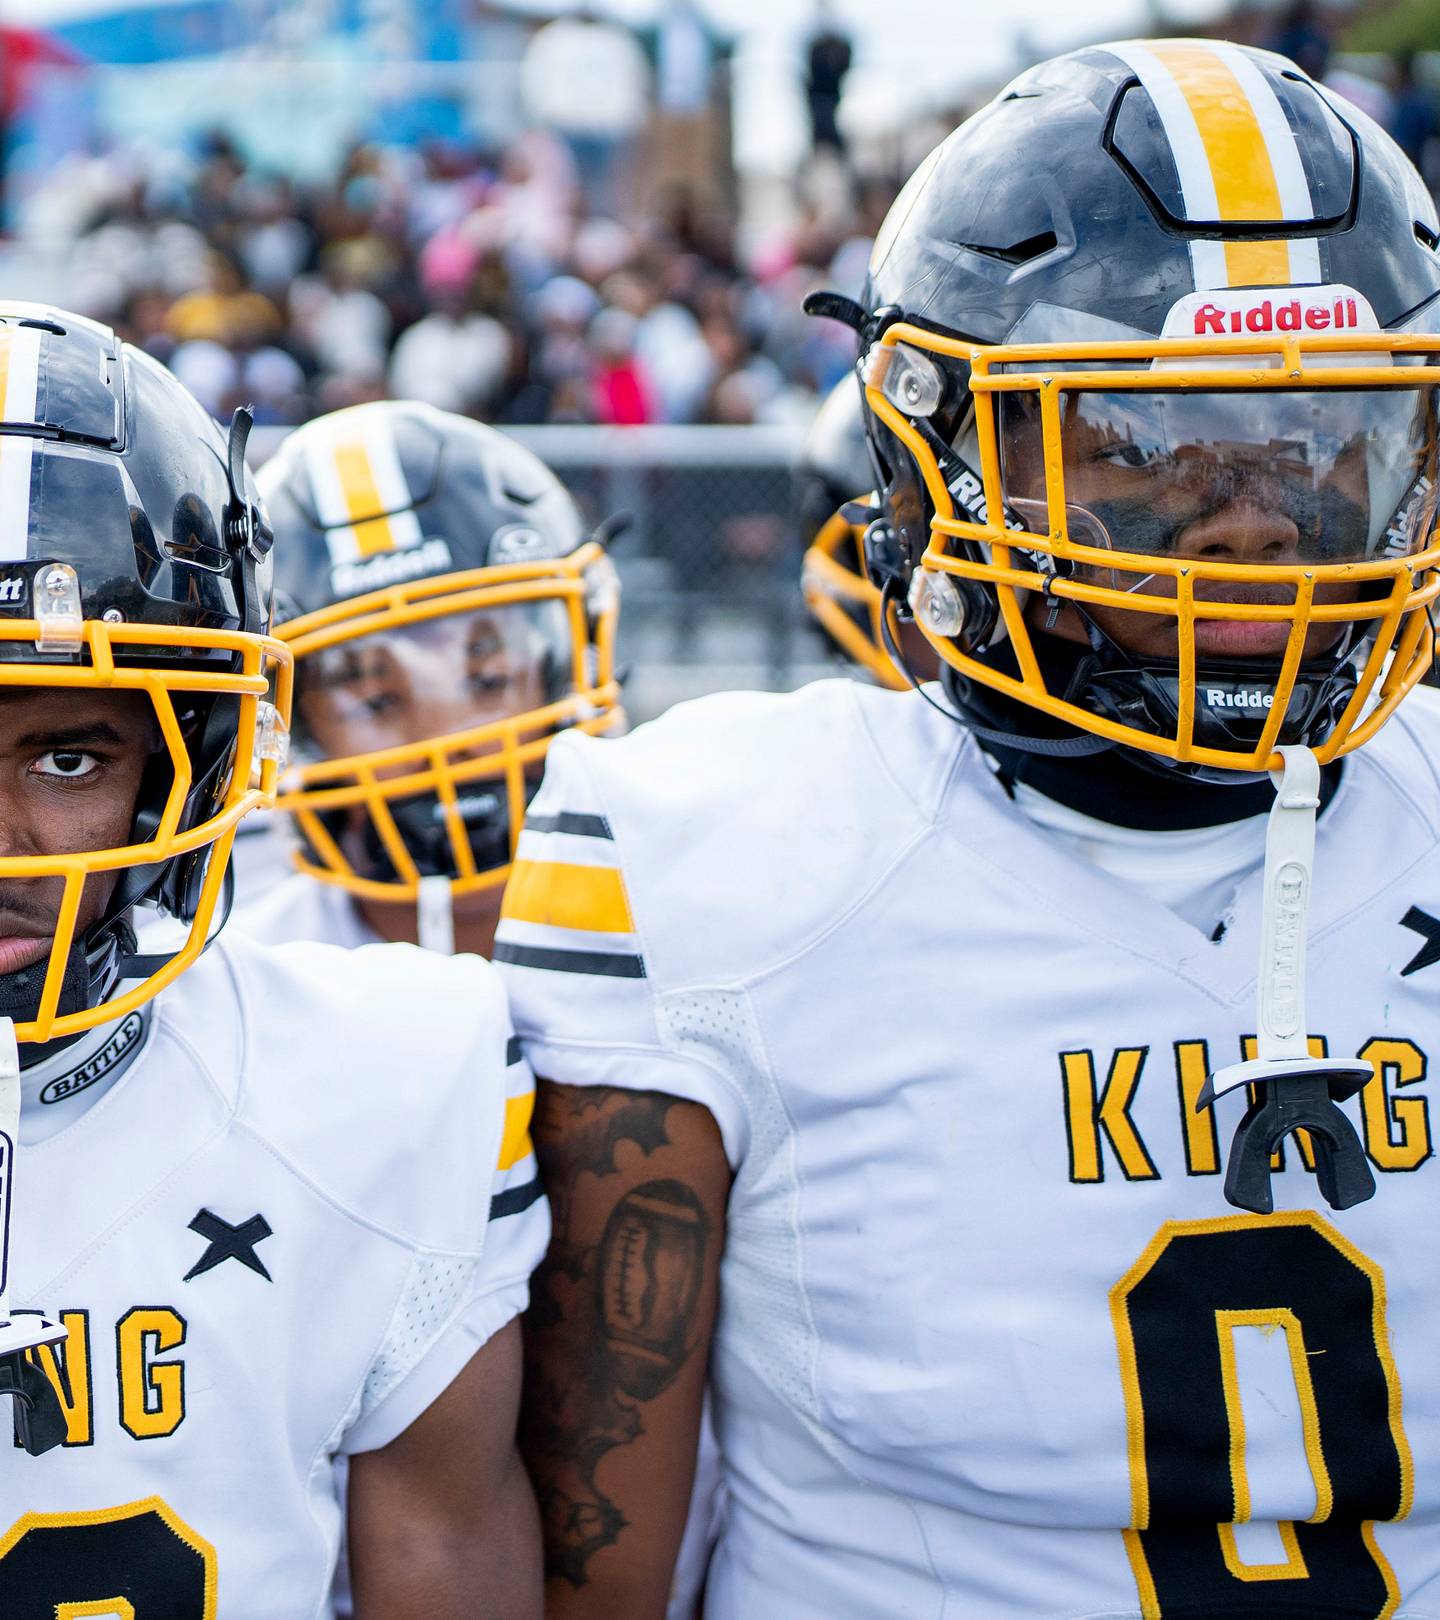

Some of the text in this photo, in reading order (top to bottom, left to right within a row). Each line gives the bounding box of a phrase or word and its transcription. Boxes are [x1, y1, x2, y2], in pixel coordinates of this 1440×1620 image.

[1194, 296, 1358, 335] Riddell
[1206, 688, 1275, 709] Ridde
[52, 1021, 137, 1099] BATTLE
[1109, 1209, 1416, 1620] 0
